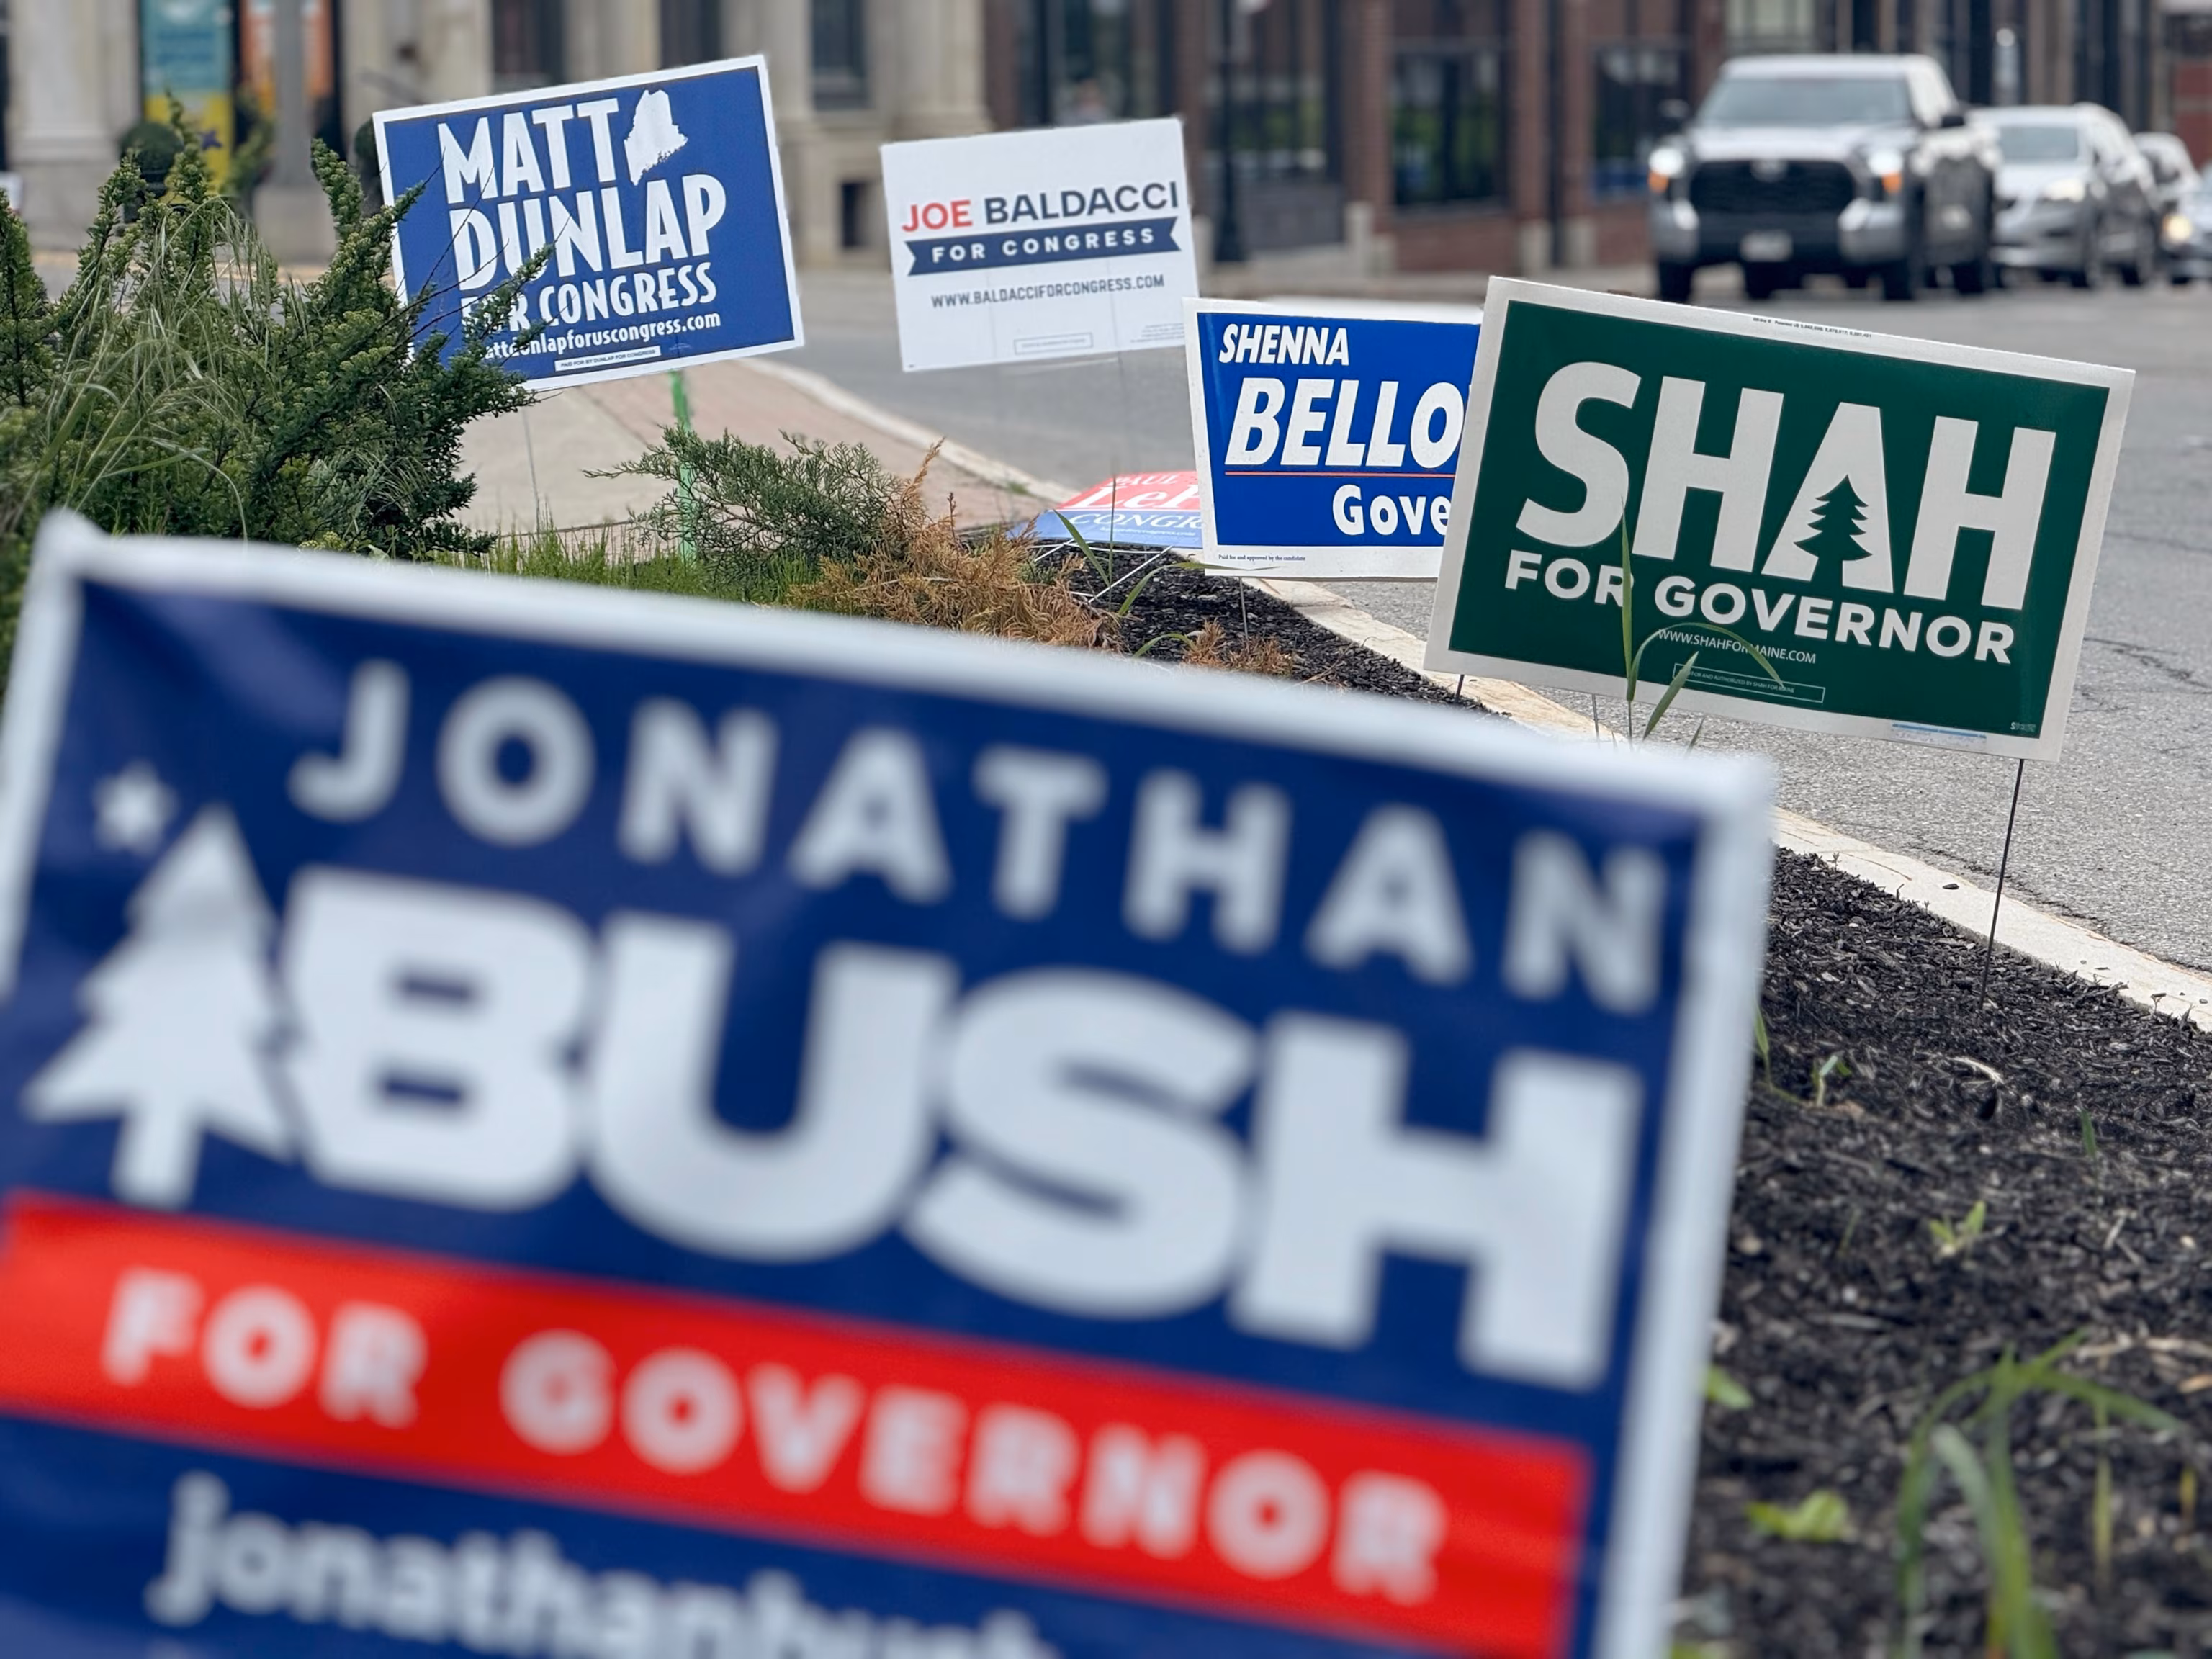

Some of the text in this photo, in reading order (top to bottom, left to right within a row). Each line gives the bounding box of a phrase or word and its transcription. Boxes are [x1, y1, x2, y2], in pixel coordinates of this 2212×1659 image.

[438, 98, 619, 204] MATT
[449, 174, 727, 291] DUNLAP
[902, 181, 1179, 233] JOE BALDACCI
[932, 228, 1154, 264] FOR CONGRESS
[461, 262, 717, 336] FR CONGRESS
[931, 274, 1165, 308] WWW.BALDACCIFORCONGRESS.COM
[1218, 323, 1349, 366] SHENNA
[1224, 377, 1471, 468] BELLO
[1105, 475, 1181, 487] PAUL
[1515, 361, 2056, 611] SHAH
[1505, 549, 2014, 665] FOR GOVERNOR
[287, 657, 1667, 1010] JONATHAN
[283, 866, 1646, 1391] BUSH
[100, 1264, 1450, 1606] FOR GOVERNOR
